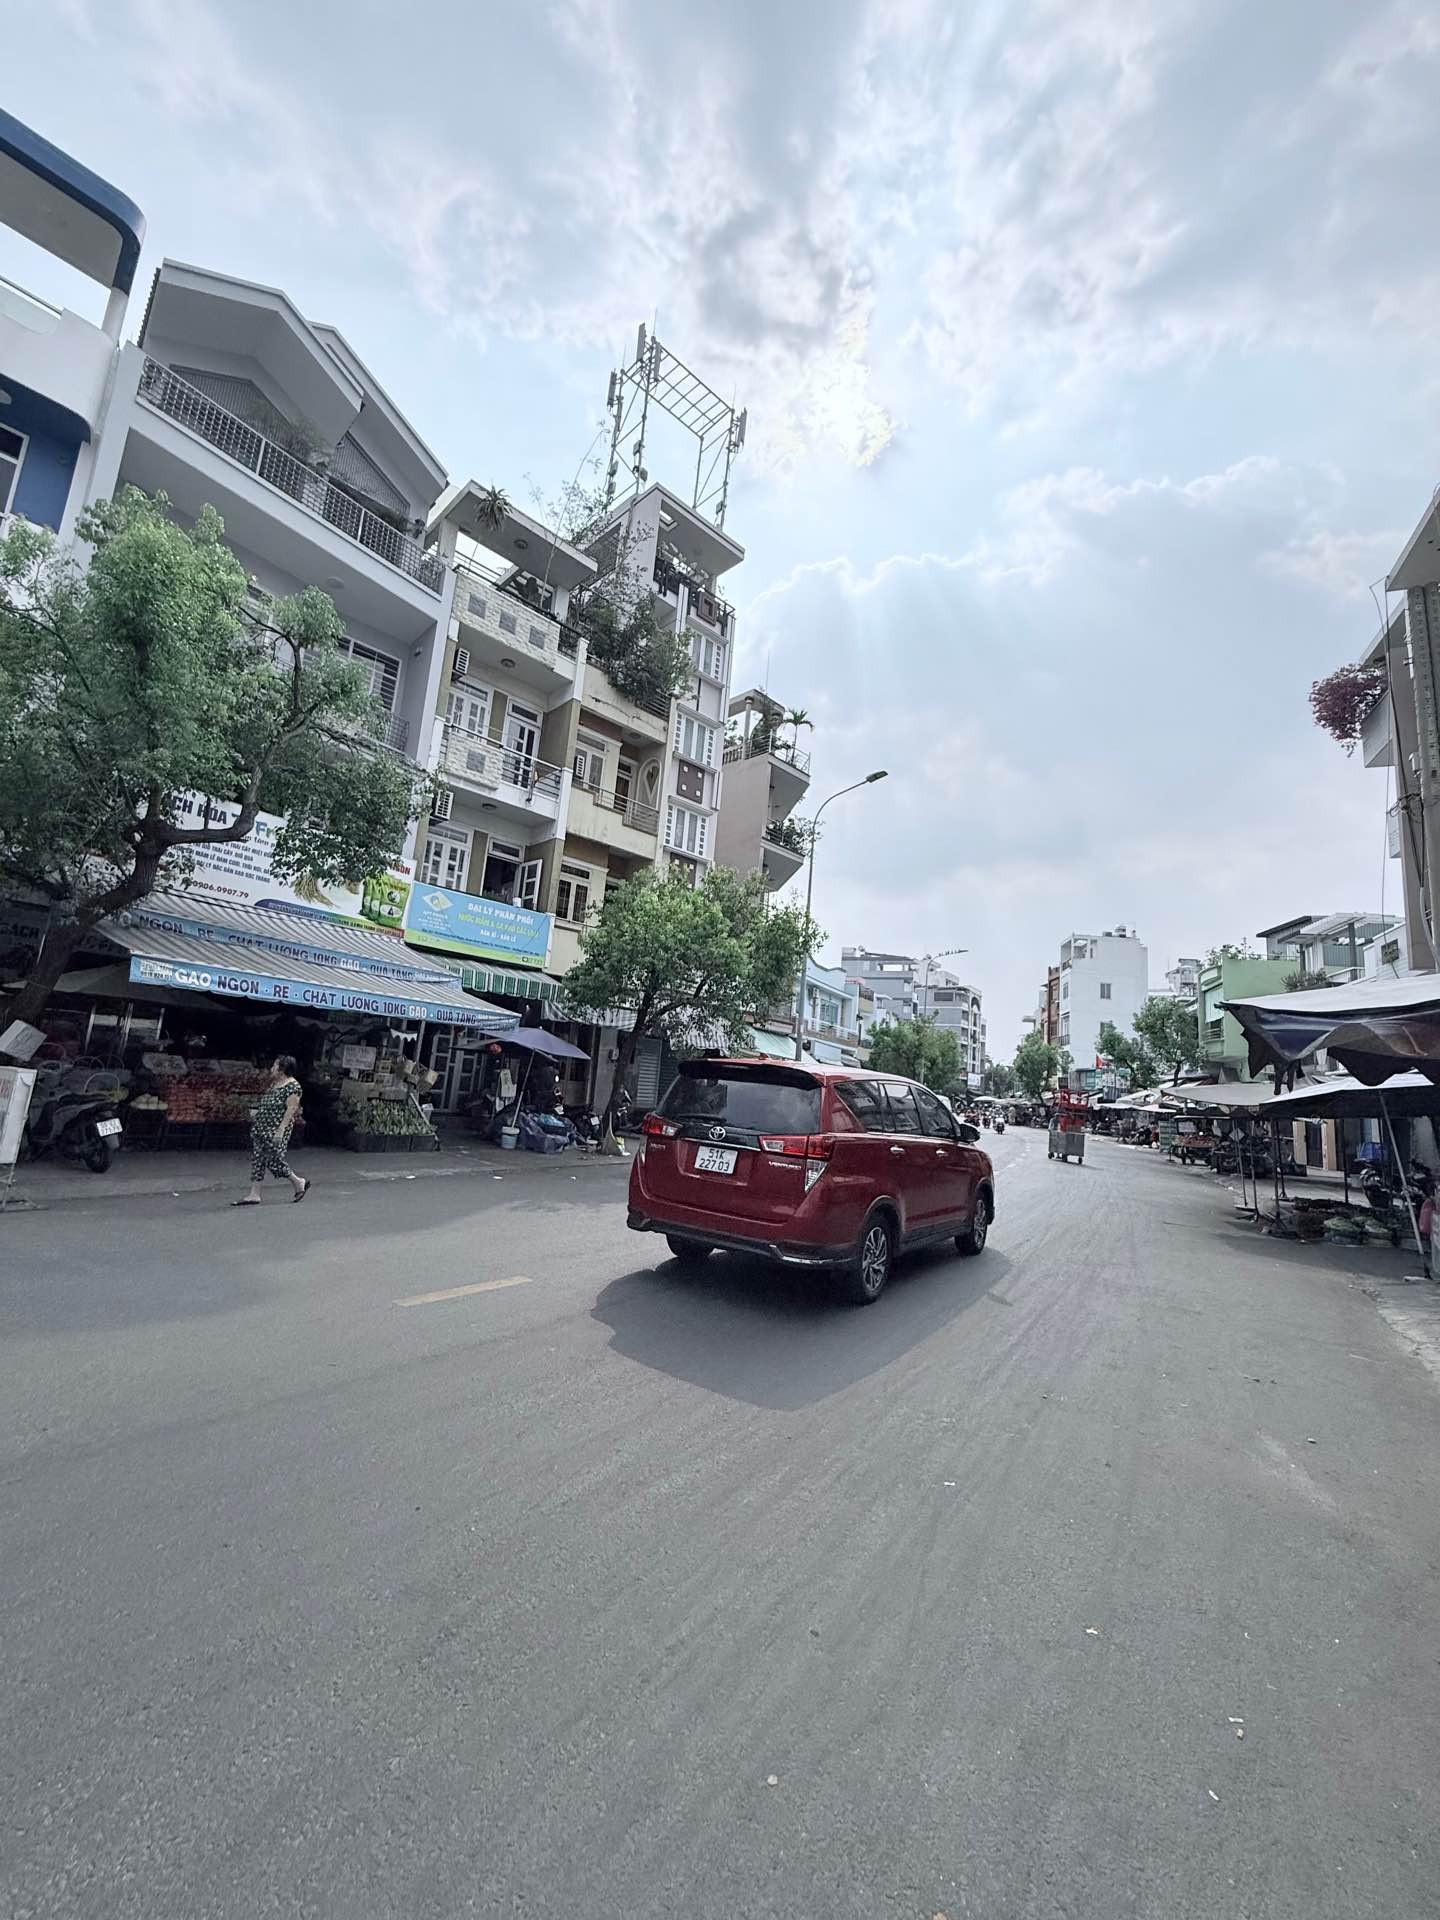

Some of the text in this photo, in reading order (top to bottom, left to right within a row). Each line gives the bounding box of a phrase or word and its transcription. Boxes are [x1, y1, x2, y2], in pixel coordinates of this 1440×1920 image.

[217, 975, 260, 994] NGON
[383, 1001, 406, 1016] 10KG
[708, 1148, 726, 1160] 51K
[698, 1158, 730, 1172] 227.03
